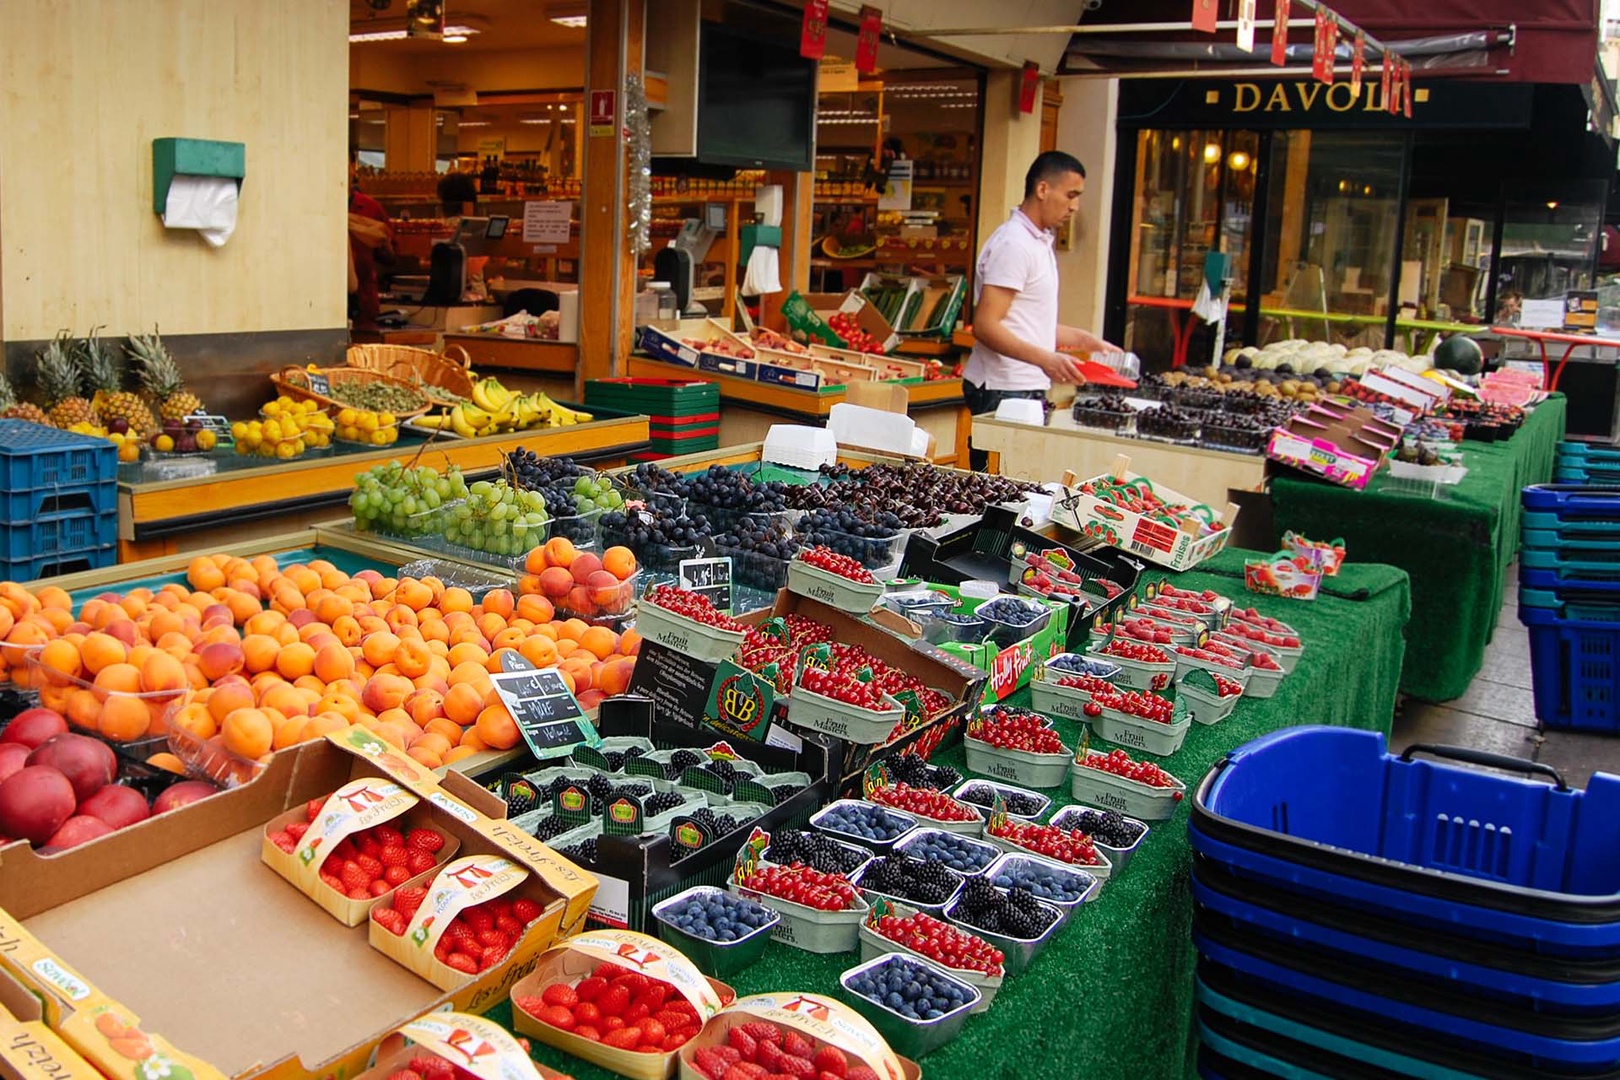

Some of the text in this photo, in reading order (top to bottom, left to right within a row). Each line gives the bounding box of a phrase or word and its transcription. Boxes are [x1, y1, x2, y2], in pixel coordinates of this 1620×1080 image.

[1170, 535, 1191, 569] Fraises
[816, 586, 835, 598] Fruit
[667, 631, 688, 645] Fruit
[990, 655, 1013, 691] Holly
[1059, 702, 1077, 712] Fruit
[826, 717, 848, 731] Fruit
[1123, 729, 1144, 741] Fruit
[996, 763, 1016, 774] Fruit
[1105, 793, 1126, 805] Fruit
